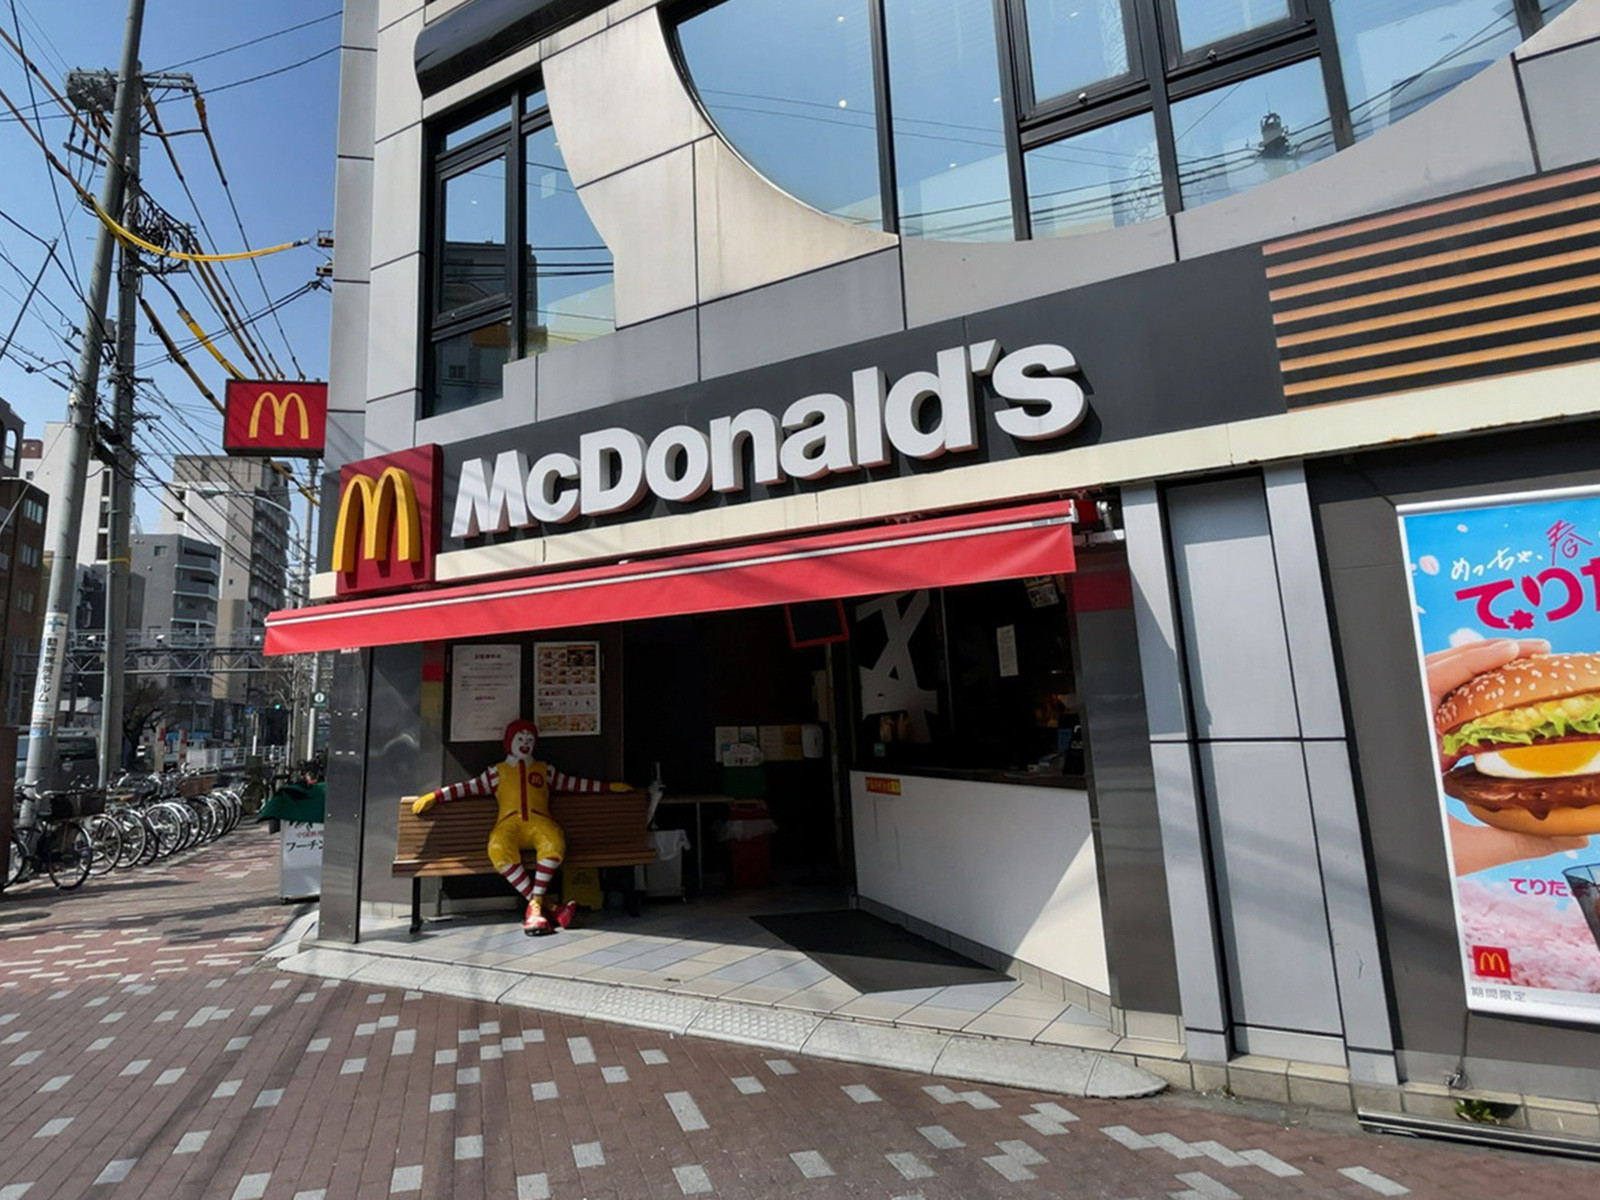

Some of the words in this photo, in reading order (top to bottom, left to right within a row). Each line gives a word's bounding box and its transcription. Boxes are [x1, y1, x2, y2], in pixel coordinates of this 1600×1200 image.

[451, 339, 1088, 539] McDonald's
[1471, 986, 1526, 1002] 期間限定
